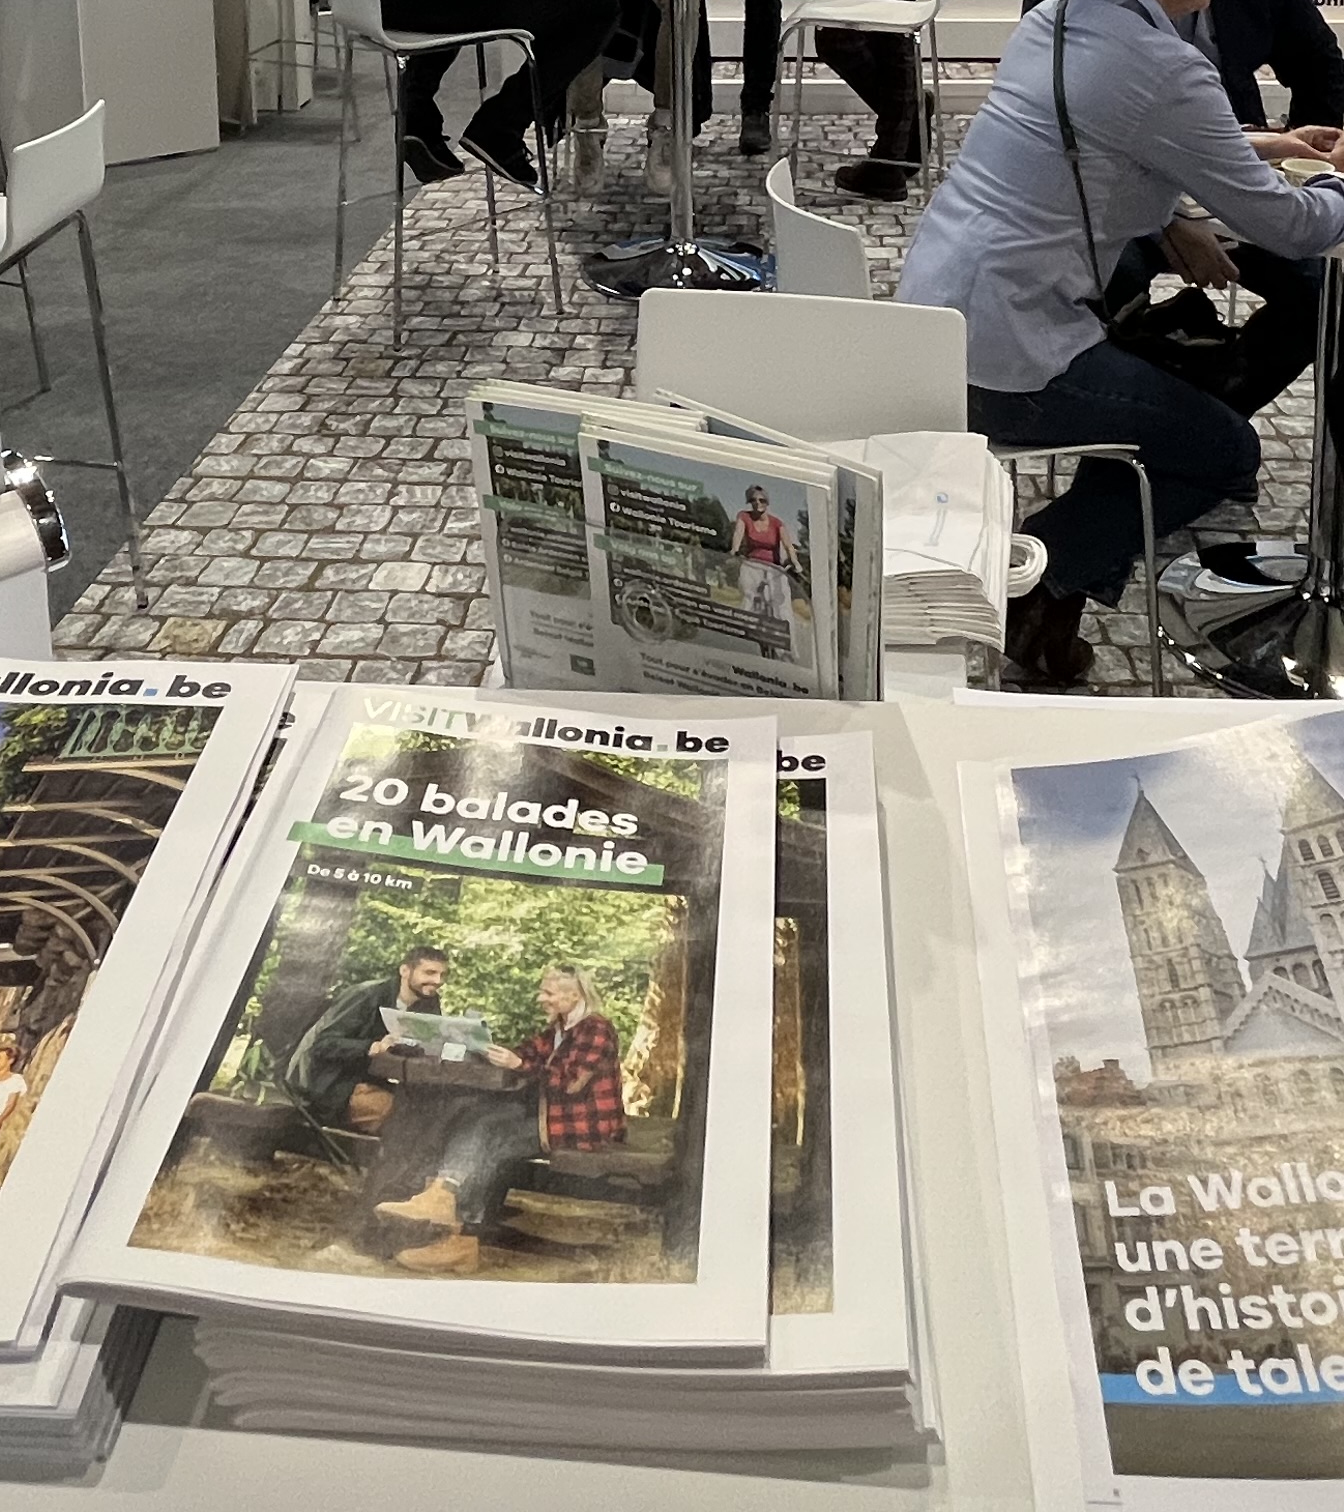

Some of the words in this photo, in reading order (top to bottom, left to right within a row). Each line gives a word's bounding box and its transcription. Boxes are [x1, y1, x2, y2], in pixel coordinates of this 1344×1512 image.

[339, 774, 410, 808] 20
[420, 789, 640, 838] balades
[326, 816, 393, 845] en
[410, 820, 650, 876] Wallonie
[308, 864, 330, 877] De
[334, 868, 345, 879] 5
[347, 868, 362, 881] à
[364, 872, 381, 885] 10
[385, 875, 413, 890] km
[1105, 1180, 1176, 1217] La
[1114, 1237, 1225, 1273] une
[1135, 1346, 1215, 1397] de
